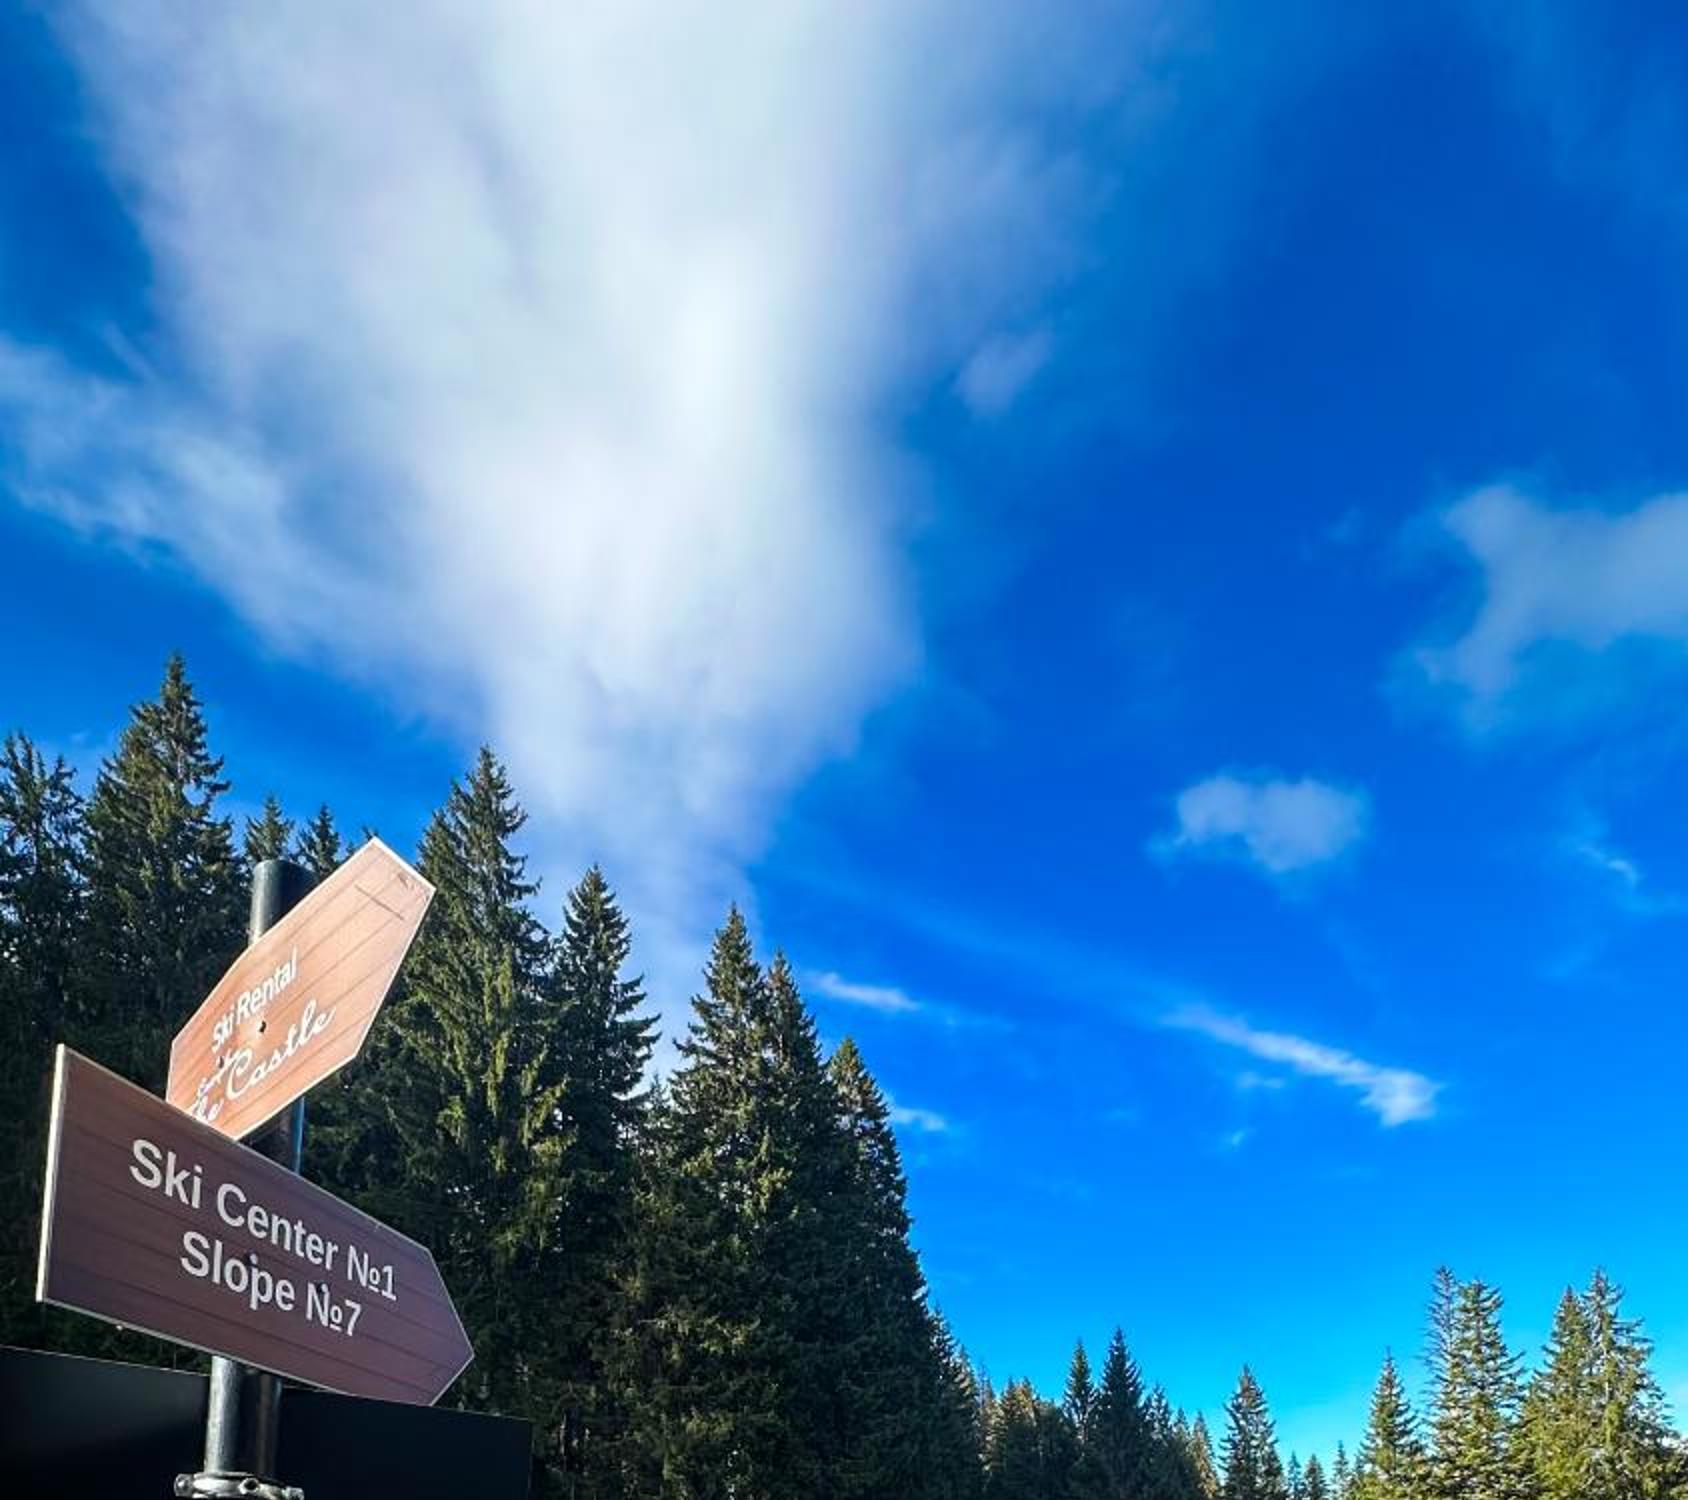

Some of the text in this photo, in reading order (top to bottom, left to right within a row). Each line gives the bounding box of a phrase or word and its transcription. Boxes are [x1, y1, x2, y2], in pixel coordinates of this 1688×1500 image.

[212, 1004, 235, 1054] Ski
[236, 943, 297, 1024] Rental
[225, 999, 337, 1100] Castle
[129, 1139, 203, 1210] Ski
[216, 1182, 339, 1271] Center
[180, 1230, 295, 1312] Slope
